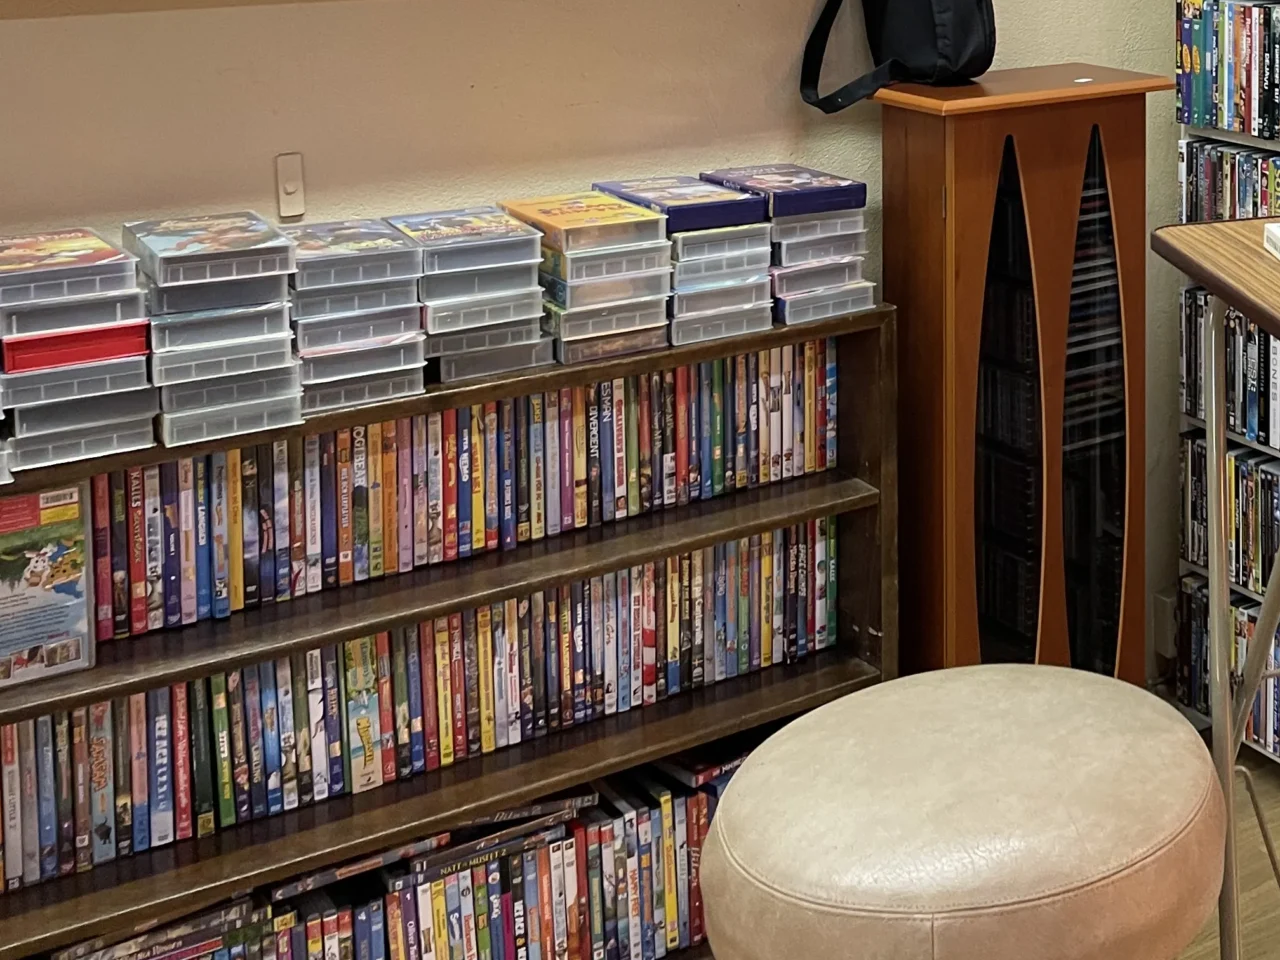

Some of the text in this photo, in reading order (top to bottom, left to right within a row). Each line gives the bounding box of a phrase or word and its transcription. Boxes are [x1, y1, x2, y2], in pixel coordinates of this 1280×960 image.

[1271, 345, 1279, 401] BONES
[590, 406, 599, 457] DIVERGENT
[131, 470, 141, 507] KALLES
[407, 921, 416, 944] Oliver
